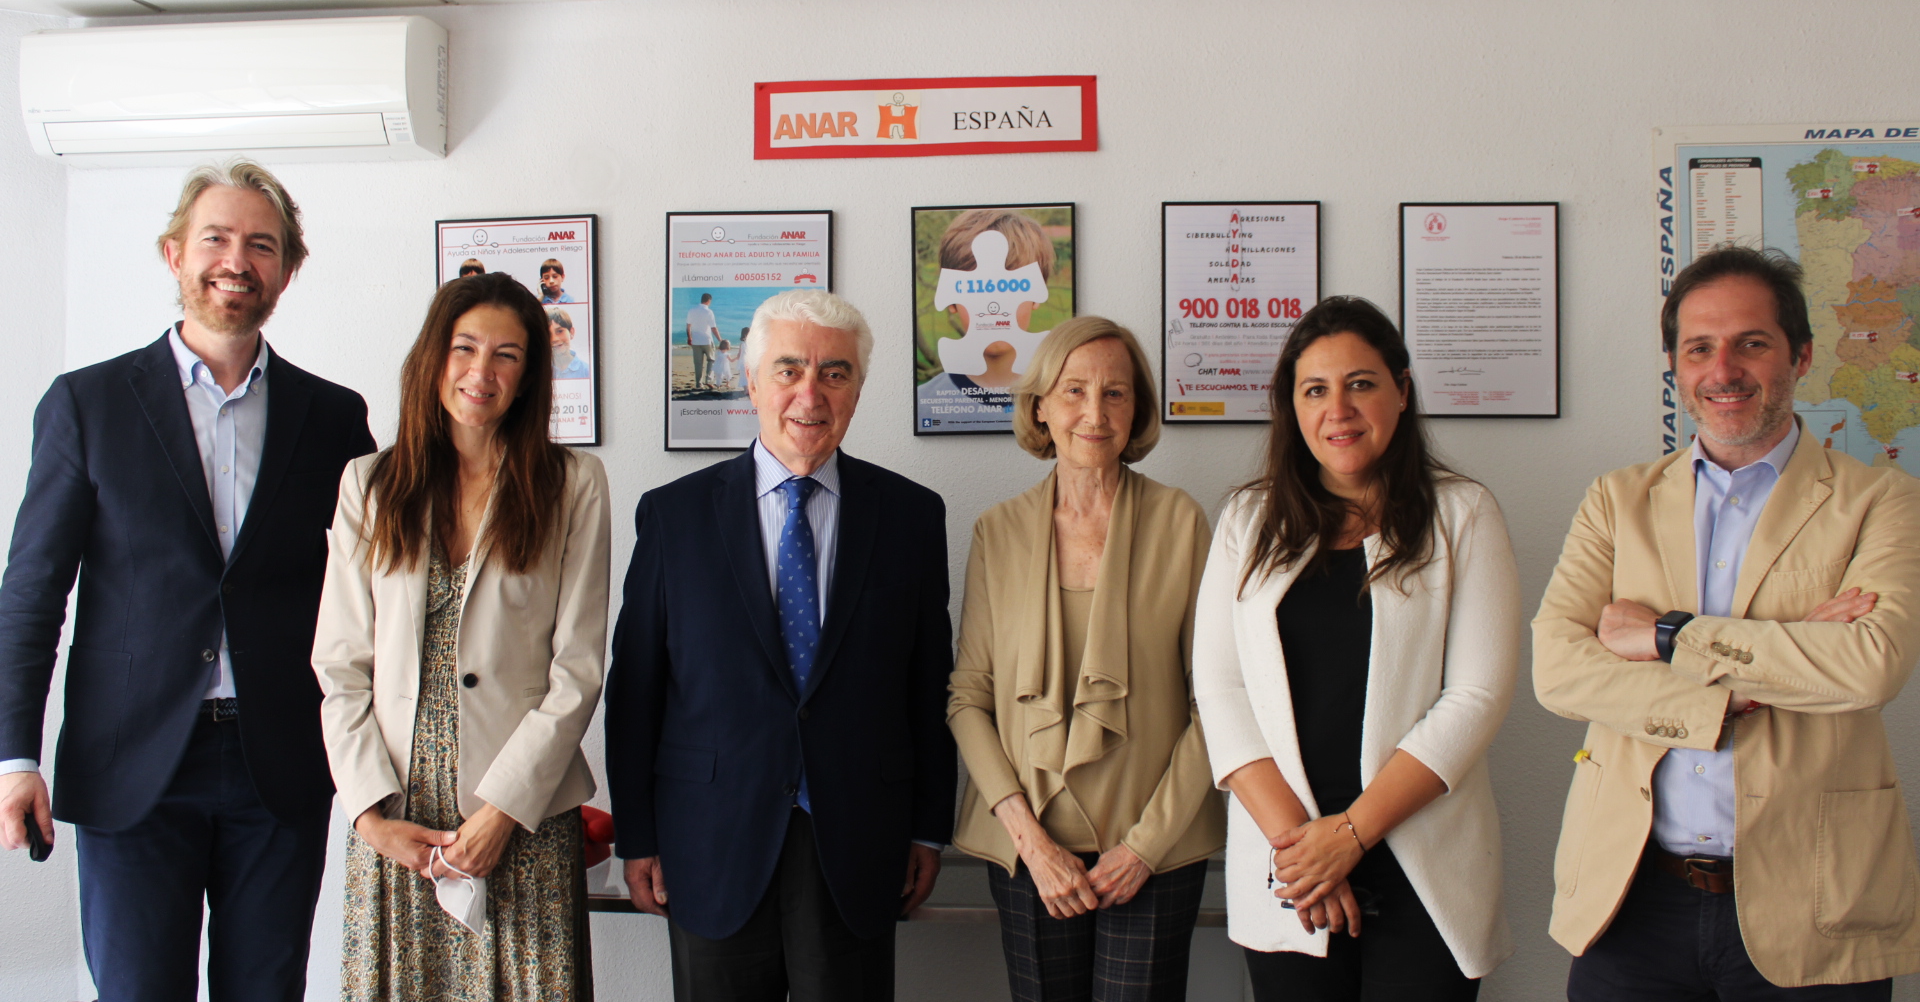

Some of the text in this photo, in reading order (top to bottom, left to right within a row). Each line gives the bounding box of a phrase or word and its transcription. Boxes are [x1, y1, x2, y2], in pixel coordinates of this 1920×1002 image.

[774, 111, 859, 140] ANAR
[953, 105, 1053, 131] ESPAÑA
[1804, 128, 1919, 139] MAPA DE
[548, 231, 575, 240] ANAR
[780, 230, 806, 240] ANAR
[1657, 166, 1674, 297] ESPAÑA
[678, 250, 712, 258] TELÉFONO
[1209, 258, 1252, 268] SOLEDAD
[734, 272, 782, 281] 600505152
[1208, 274, 1256, 284] AMENAZAS
[1179, 298, 1302, 318] 900 018 018
[1198, 368, 1218, 376] CHAT
[1219, 368, 1242, 376] ANAR
[961, 386, 1010, 395] DESAPAREC
[1196, 384, 1248, 392] ESCUCHAMOS,
[562, 405, 574, 414] 20
[578, 404, 588, 414] 10
[930, 404, 975, 414] TELÉFONO
[978, 405, 1002, 413] ANAR
[1663, 370, 1676, 456] MAPA
